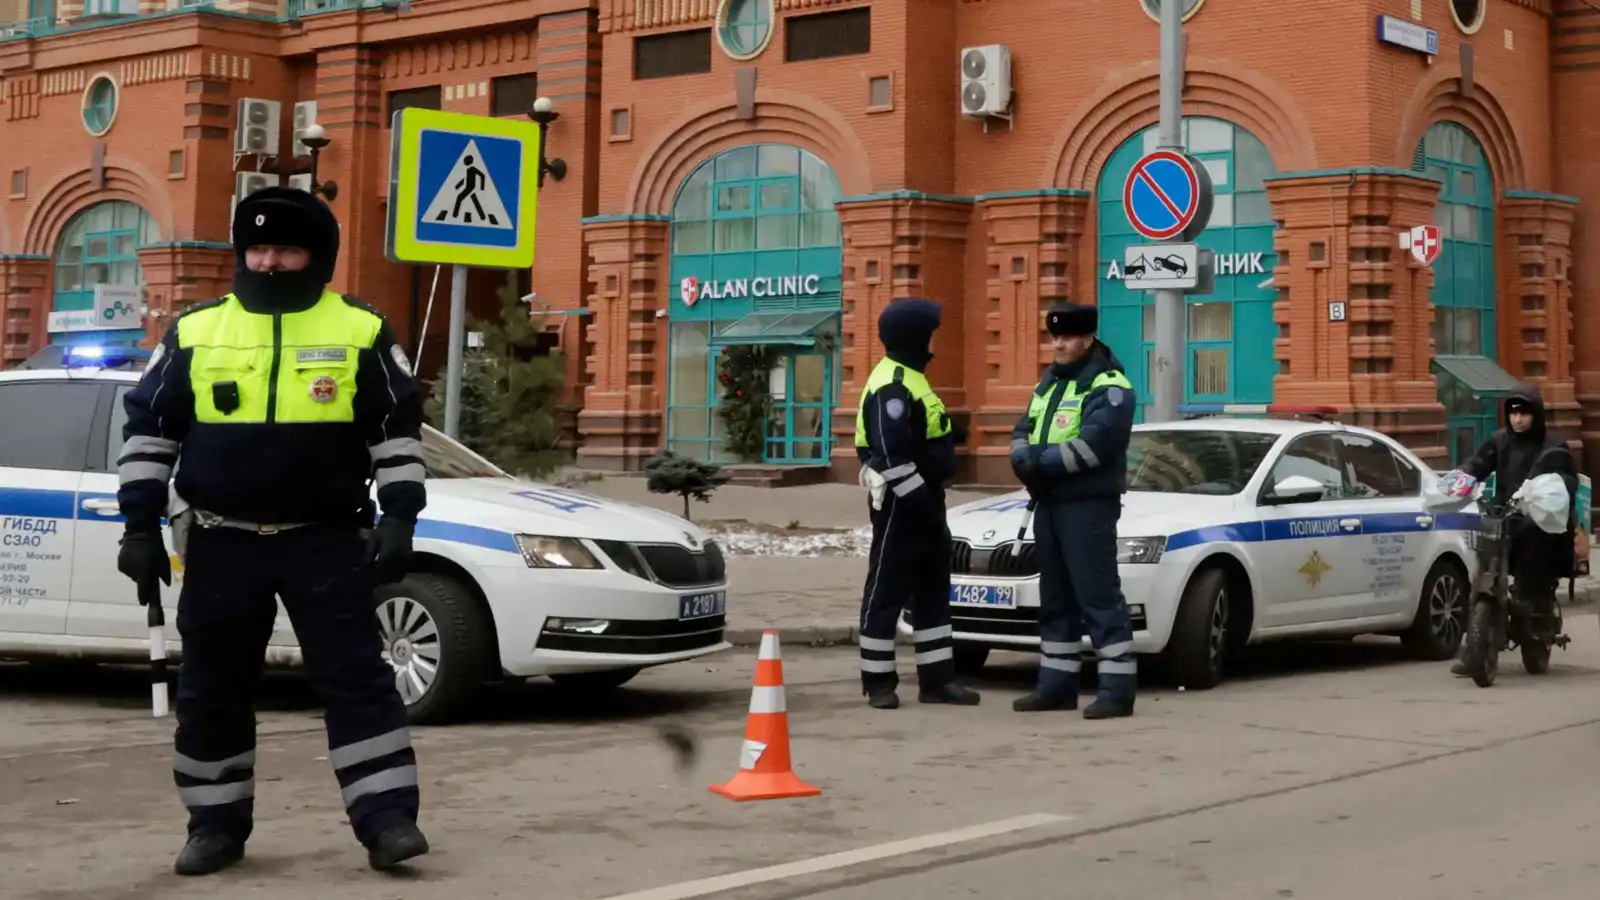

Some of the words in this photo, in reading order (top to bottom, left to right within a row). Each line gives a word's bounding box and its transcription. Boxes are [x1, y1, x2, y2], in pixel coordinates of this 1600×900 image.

[700, 278, 747, 299] ALAN
[751, 275, 819, 297] CLINIC
[3, 517, 57, 535] ГИБДД
[1289, 519, 1340, 537] ПОЛИЦИЯ
[3, 534, 41, 547] СЗАО
[26, 551, 62, 561] Москве
[15, 588, 47, 597] ЧАСТИ
[954, 586, 988, 603] 1482
[996, 587, 1010, 600] 99
[683, 601, 690, 617] А
[693, 594, 714, 615] 2187
